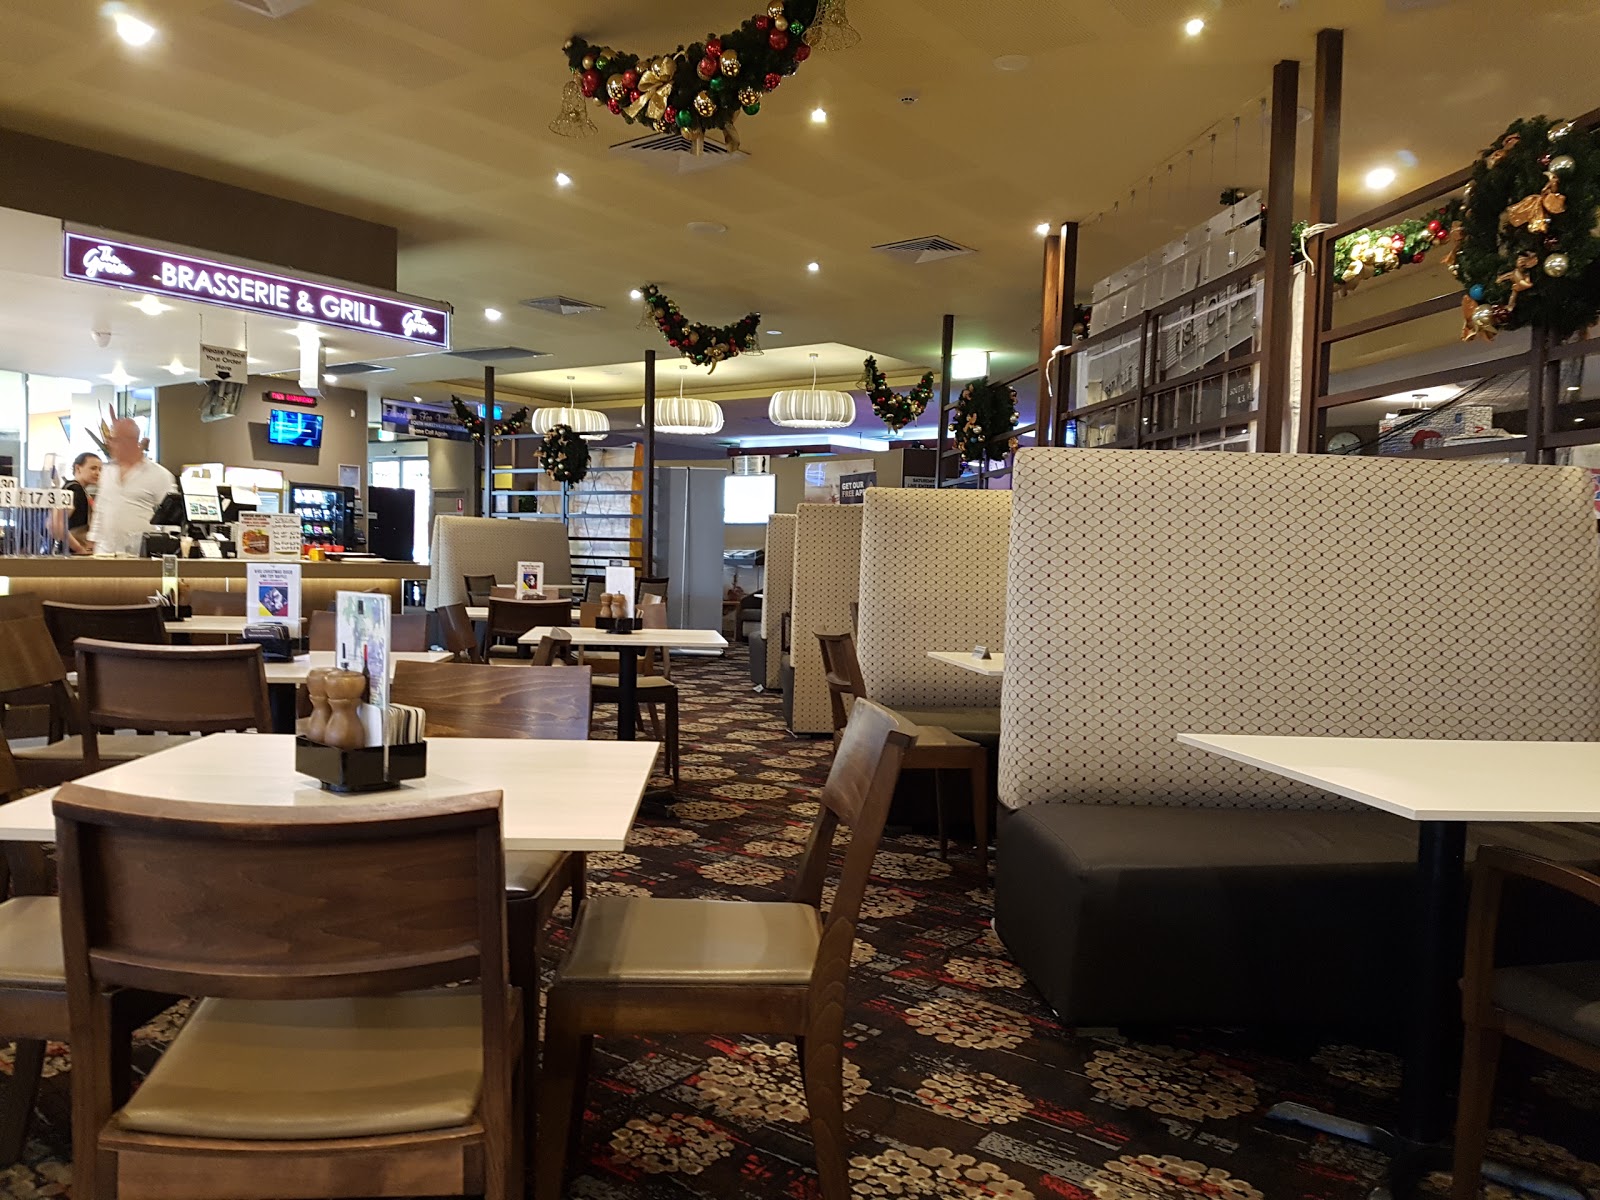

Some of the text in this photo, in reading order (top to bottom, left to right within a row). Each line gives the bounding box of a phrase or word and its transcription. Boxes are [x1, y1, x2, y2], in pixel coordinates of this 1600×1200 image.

[162, 262, 381, 327] BRASSERIE & GRILL
[203, 346, 246, 358] Please Place
[206, 354, 242, 365] Your Order
[841, 481, 865, 490] GET OUR
[29, 491, 43, 505] 17
[48, 491, 56, 505] 3
